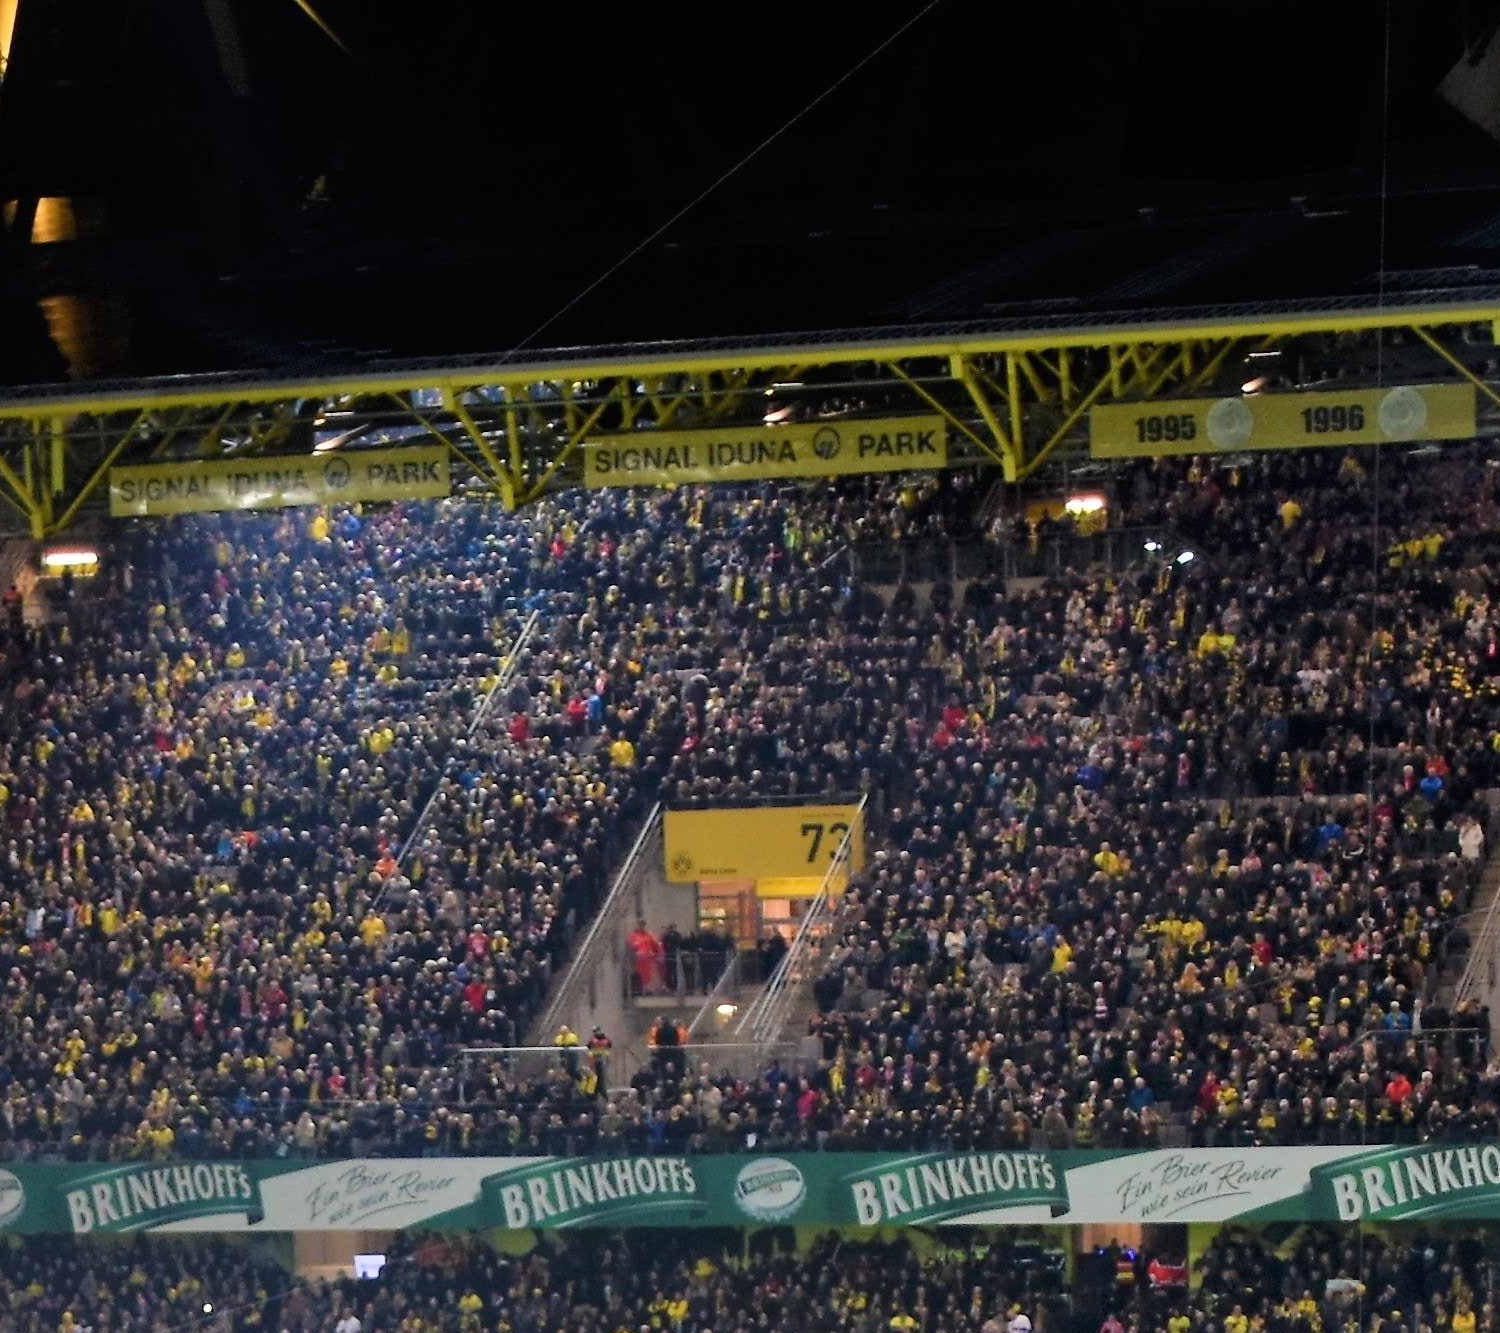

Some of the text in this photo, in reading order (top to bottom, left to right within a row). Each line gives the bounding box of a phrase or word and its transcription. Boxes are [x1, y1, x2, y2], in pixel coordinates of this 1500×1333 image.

[1135, 413, 1197, 443] 1995
[1302, 404, 1366, 433] 1996
[595, 430, 938, 473] SIGNAL IDUNA PARK
[120, 459, 440, 502] SIGNAL IDUNA PARK
[800, 824, 850, 862] 73
[1117, 1154, 1212, 1213] Ein Bier
[1211, 1160, 1284, 1191] Revier
